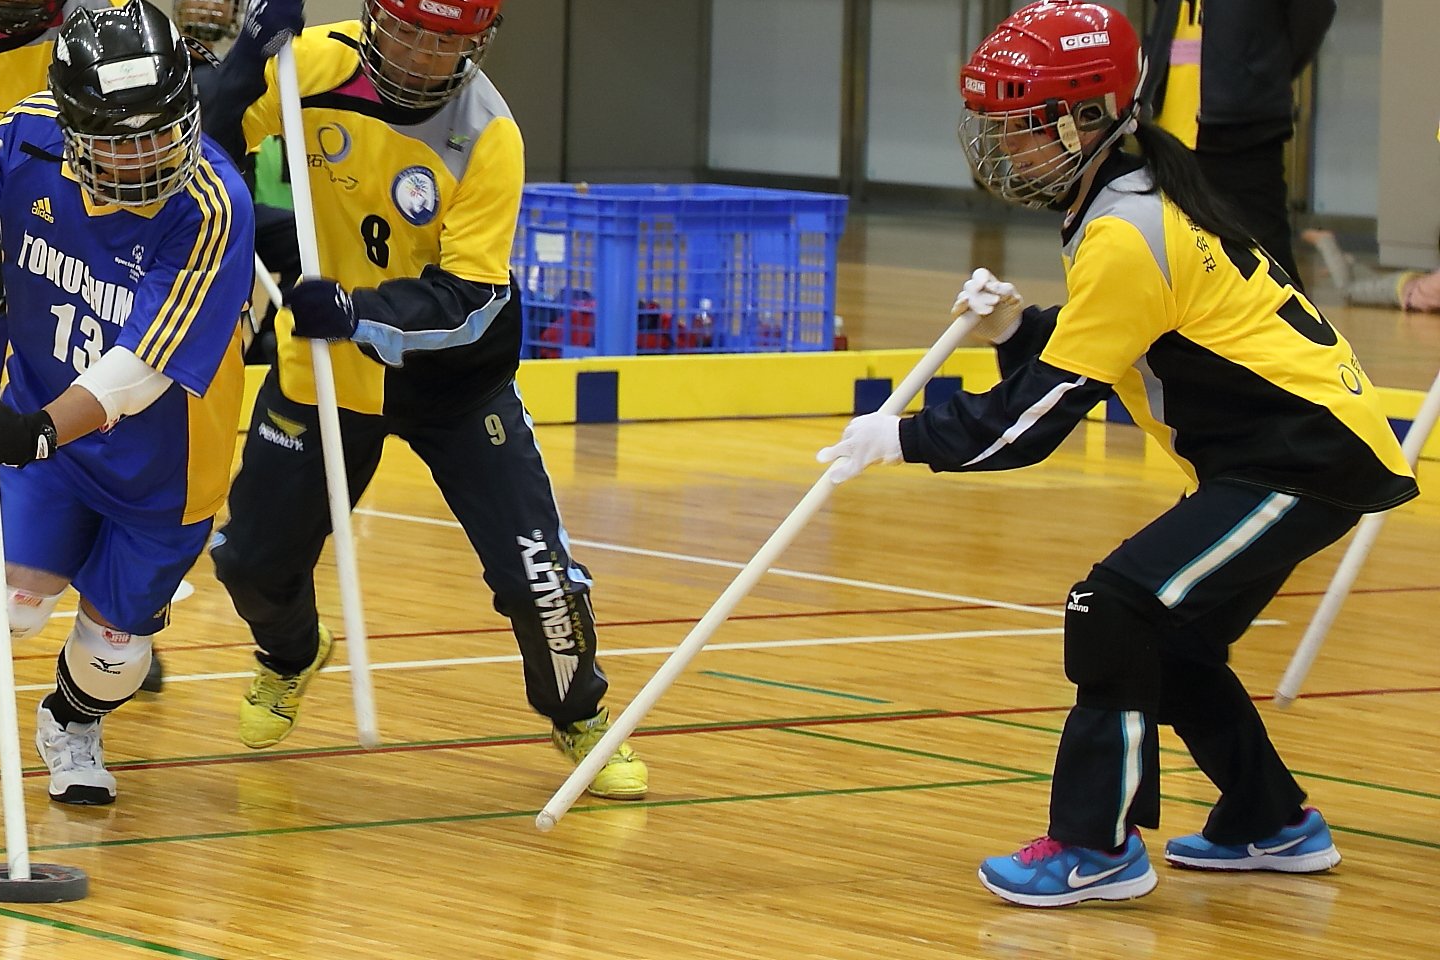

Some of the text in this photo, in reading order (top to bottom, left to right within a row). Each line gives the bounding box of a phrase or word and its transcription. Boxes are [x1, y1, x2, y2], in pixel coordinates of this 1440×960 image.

[1065, 33, 1109, 48] CCM
[31, 206, 54, 224] adidas
[360, 214, 391, 269] 8
[50, 303, 104, 376] 13
[257, 423, 304, 451] PENALTY
[484, 414, 506, 446] 9
[516, 535, 576, 652] PENALTY
